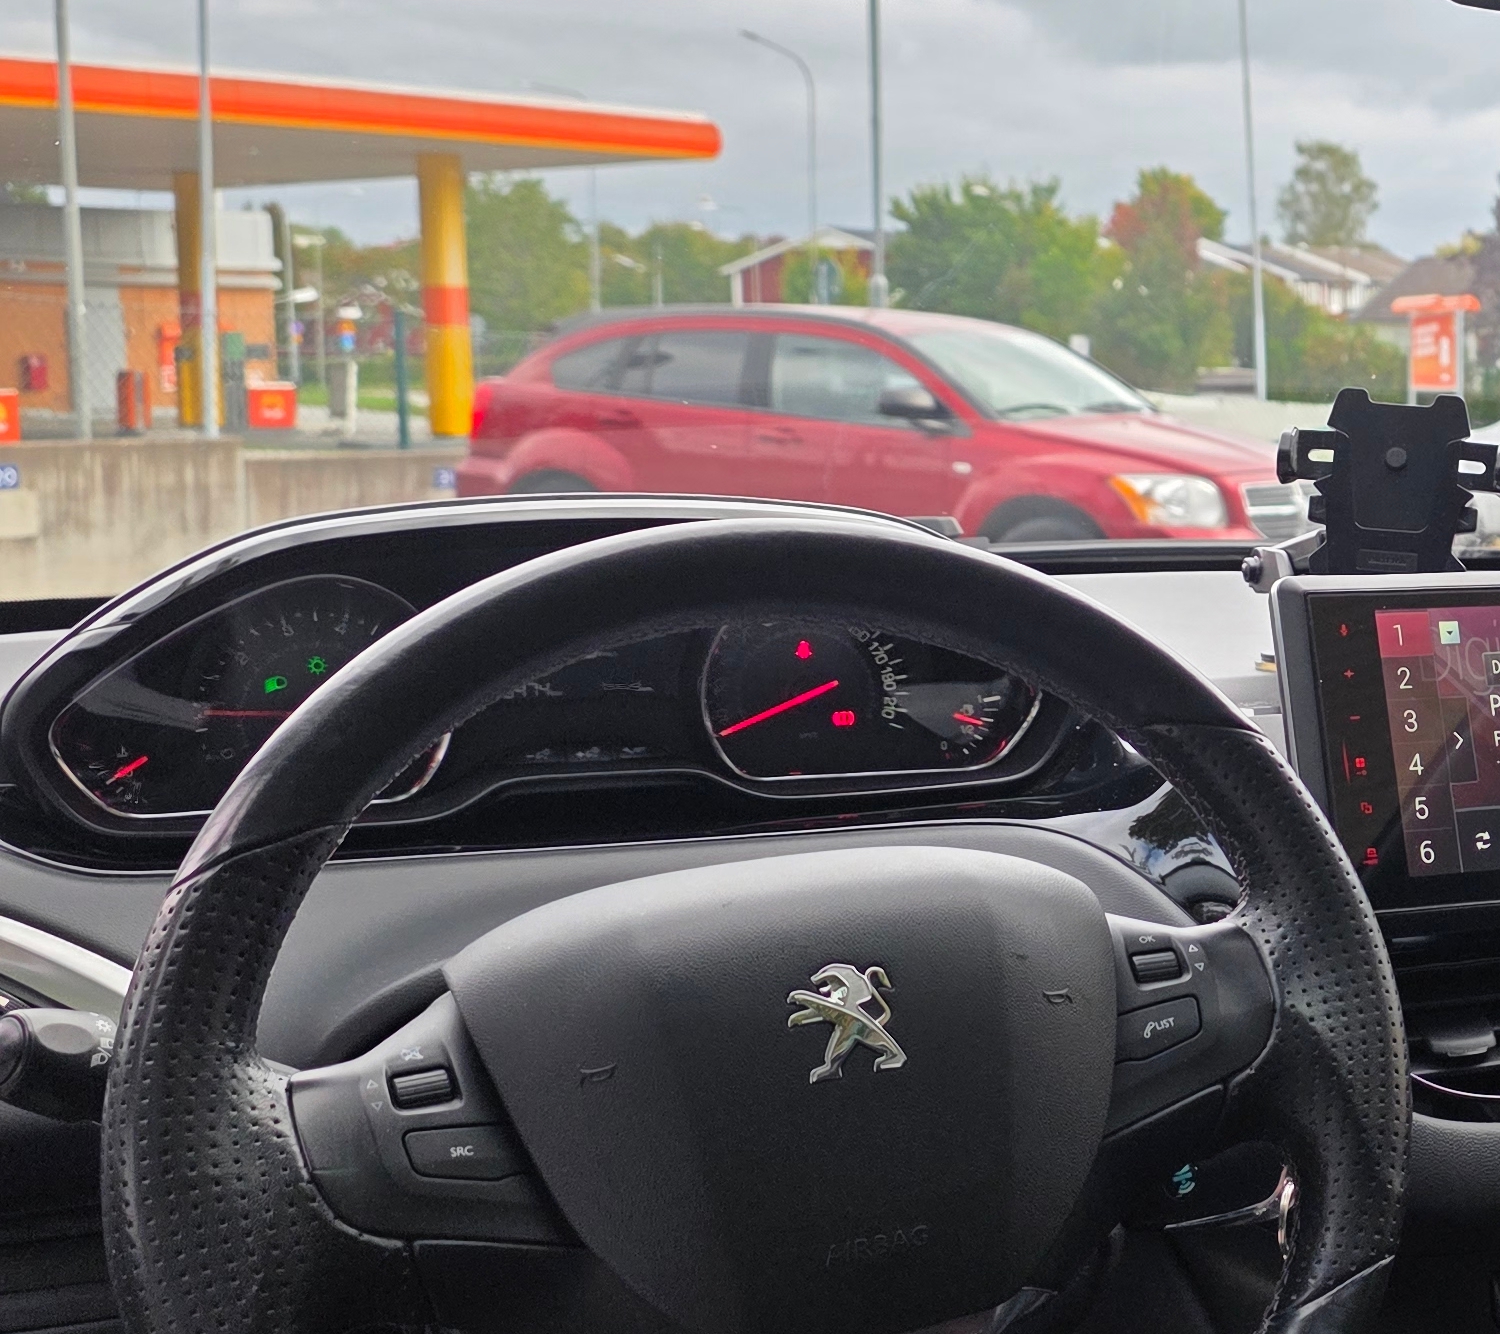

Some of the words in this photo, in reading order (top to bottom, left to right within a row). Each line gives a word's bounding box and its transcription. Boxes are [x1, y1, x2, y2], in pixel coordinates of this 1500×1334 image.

[1393, 624, 1403, 646] 1
[1397, 667, 1413, 689] 2
[1403, 710, 1418, 732] 3
[1409, 753, 1424, 776] 4
[1414, 796, 1429, 819] 5
[1420, 840, 1435, 864] 6
[1139, 935, 1156, 944] OK
[1155, 1017, 1175, 1030] LIST
[449, 1145, 475, 1157] SRC
